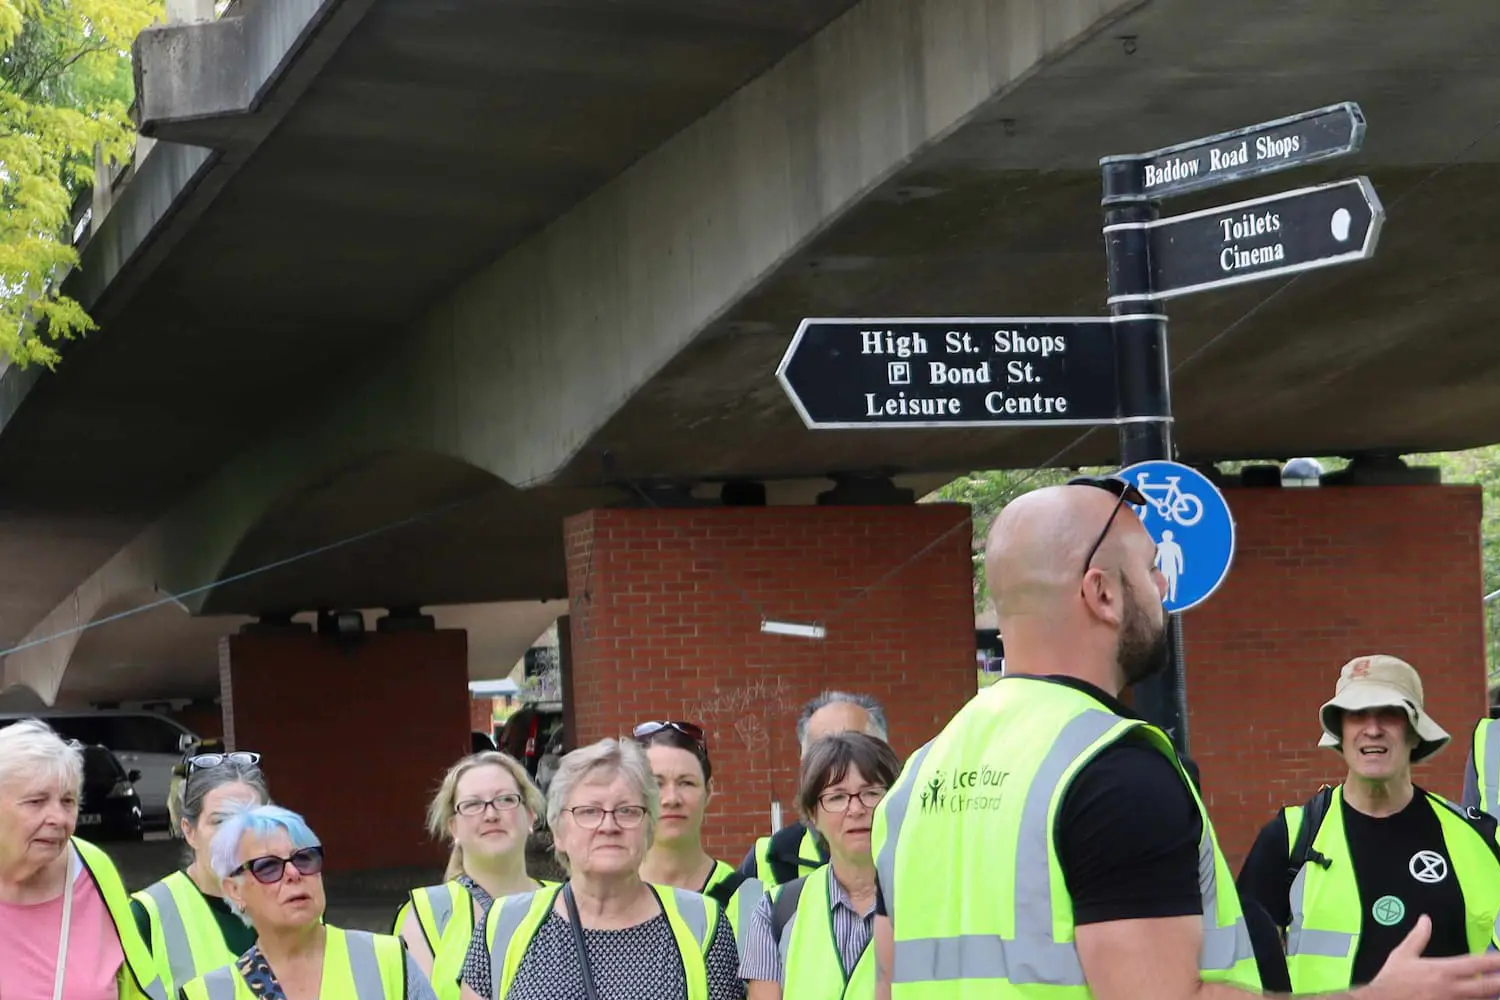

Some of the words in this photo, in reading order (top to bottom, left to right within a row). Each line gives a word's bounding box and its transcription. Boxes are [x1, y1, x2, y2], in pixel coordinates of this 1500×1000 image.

[1144, 157, 1200, 187] Baddow
[1210, 141, 1248, 171] Road
[1256, 135, 1300, 160] Shops
[1219, 210, 1281, 242] Toilets
[1220, 242, 1284, 271] Cinema
[860, 331, 928, 358] High
[945, 331, 980, 353] St.
[994, 330, 1066, 357] Shops
[928, 361, 991, 384] Bond
[1007, 360, 1041, 383] St.
[865, 392, 961, 416] Leisure
[985, 391, 1067, 414] Centre
